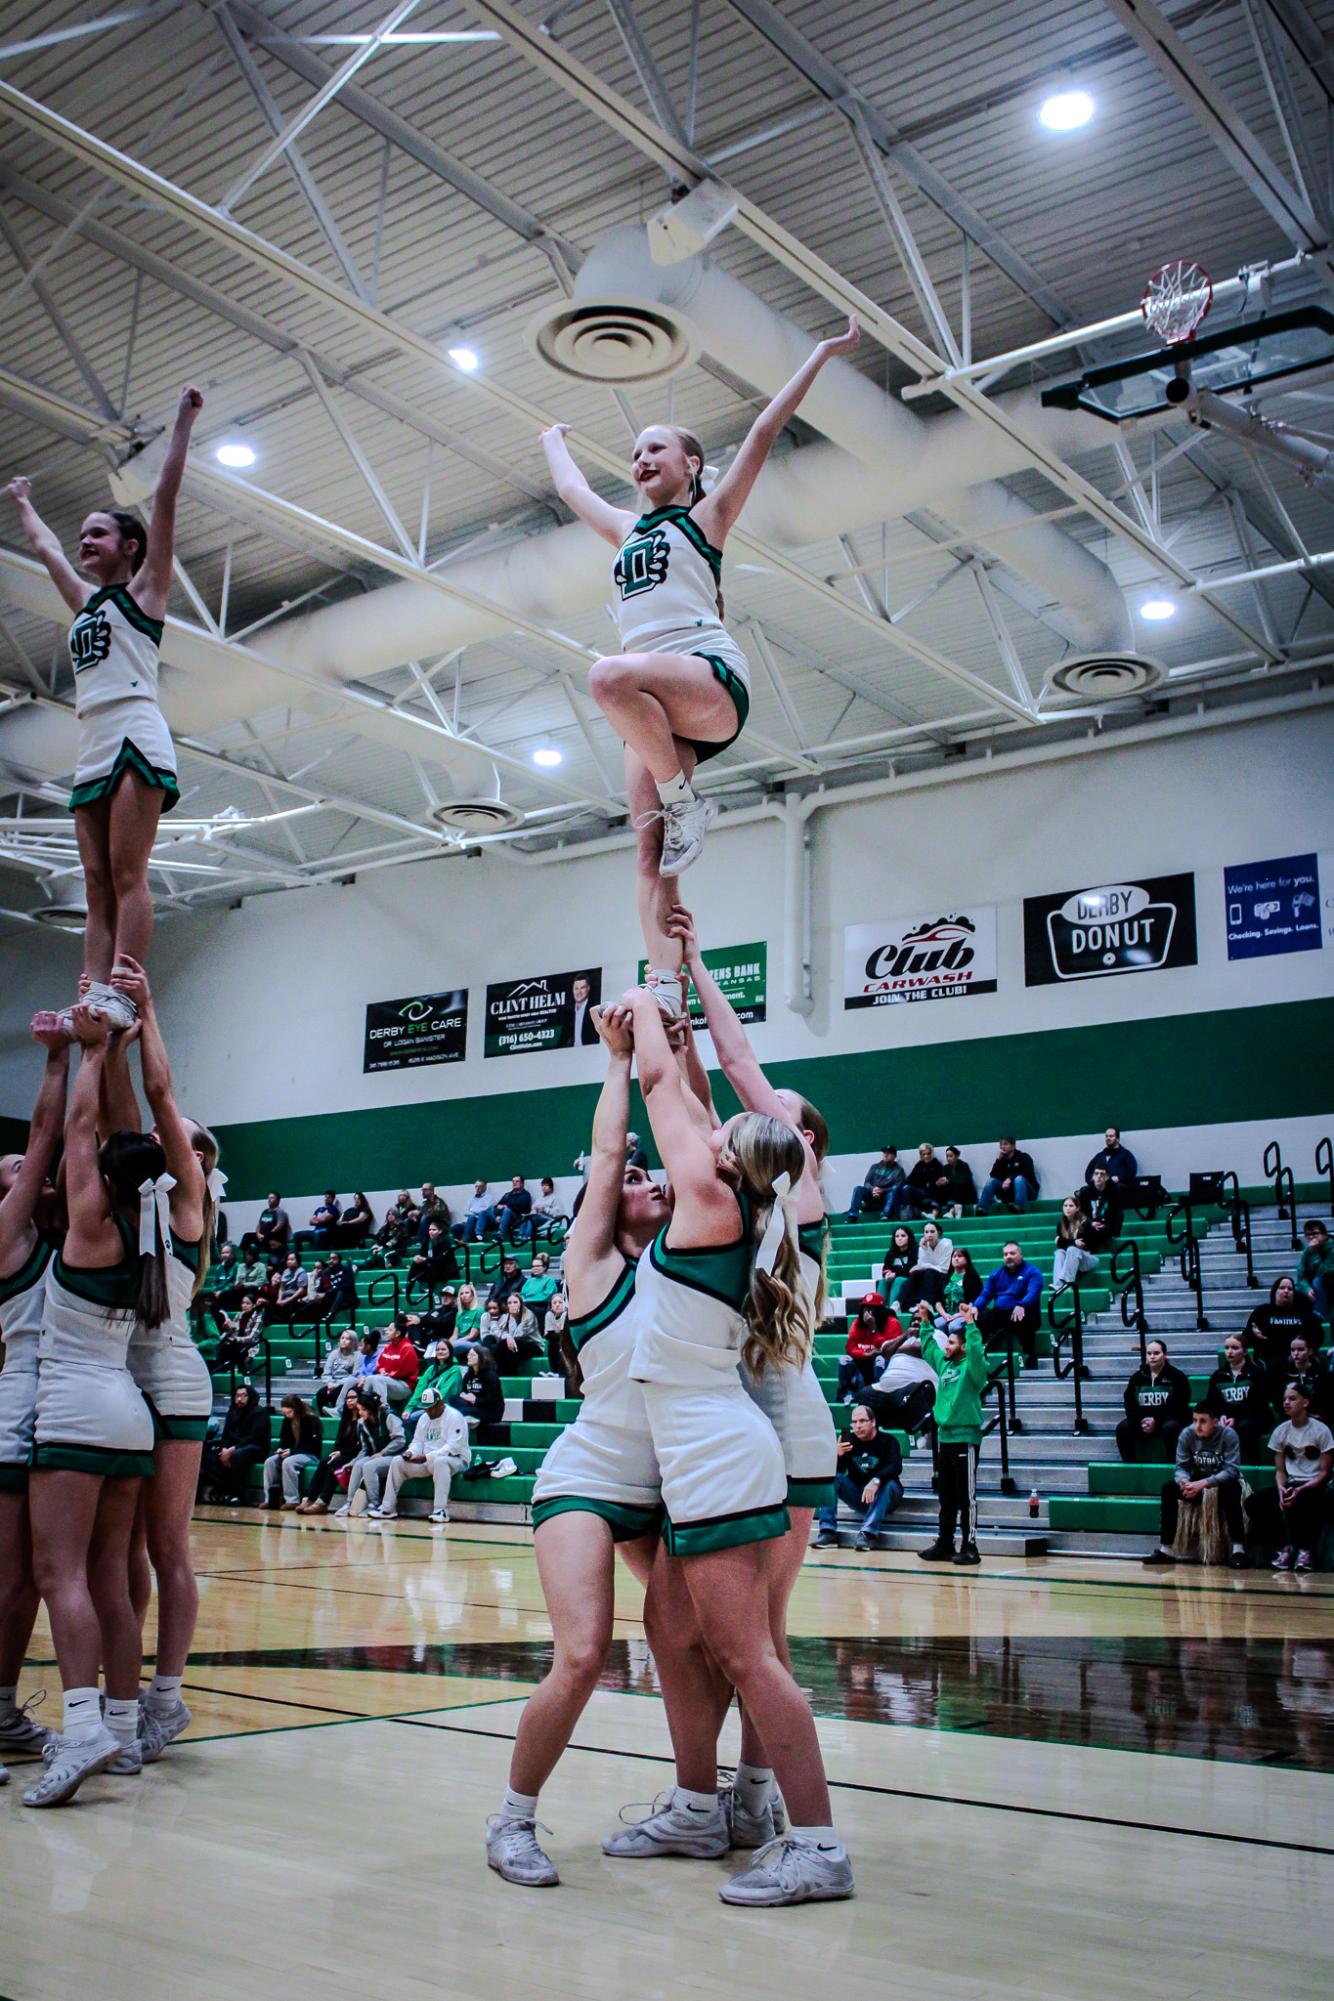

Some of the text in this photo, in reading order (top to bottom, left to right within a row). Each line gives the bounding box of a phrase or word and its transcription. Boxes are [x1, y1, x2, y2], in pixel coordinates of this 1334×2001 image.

[1227, 875, 1314, 894] We're here for you.
[1077, 890, 1133, 920] DERBY
[1072, 918, 1155, 954] DONUT
[1228, 923, 1319, 940] Checking. Savings. Loans.
[865, 938, 975, 979] Club
[734, 962, 761, 978] BANK
[863, 971, 973, 993] CARWASH
[490, 996, 528, 1015] CLINT
[529, 991, 566, 1009] HELM
[872, 985, 967, 1005] JOIN THE CLUB!
[369, 1017, 462, 1039] DERBY EYE CARE
[499, 1029, 555, 1046] (316) 650-4323
[1138, 1391, 1169, 1406] DERBY
